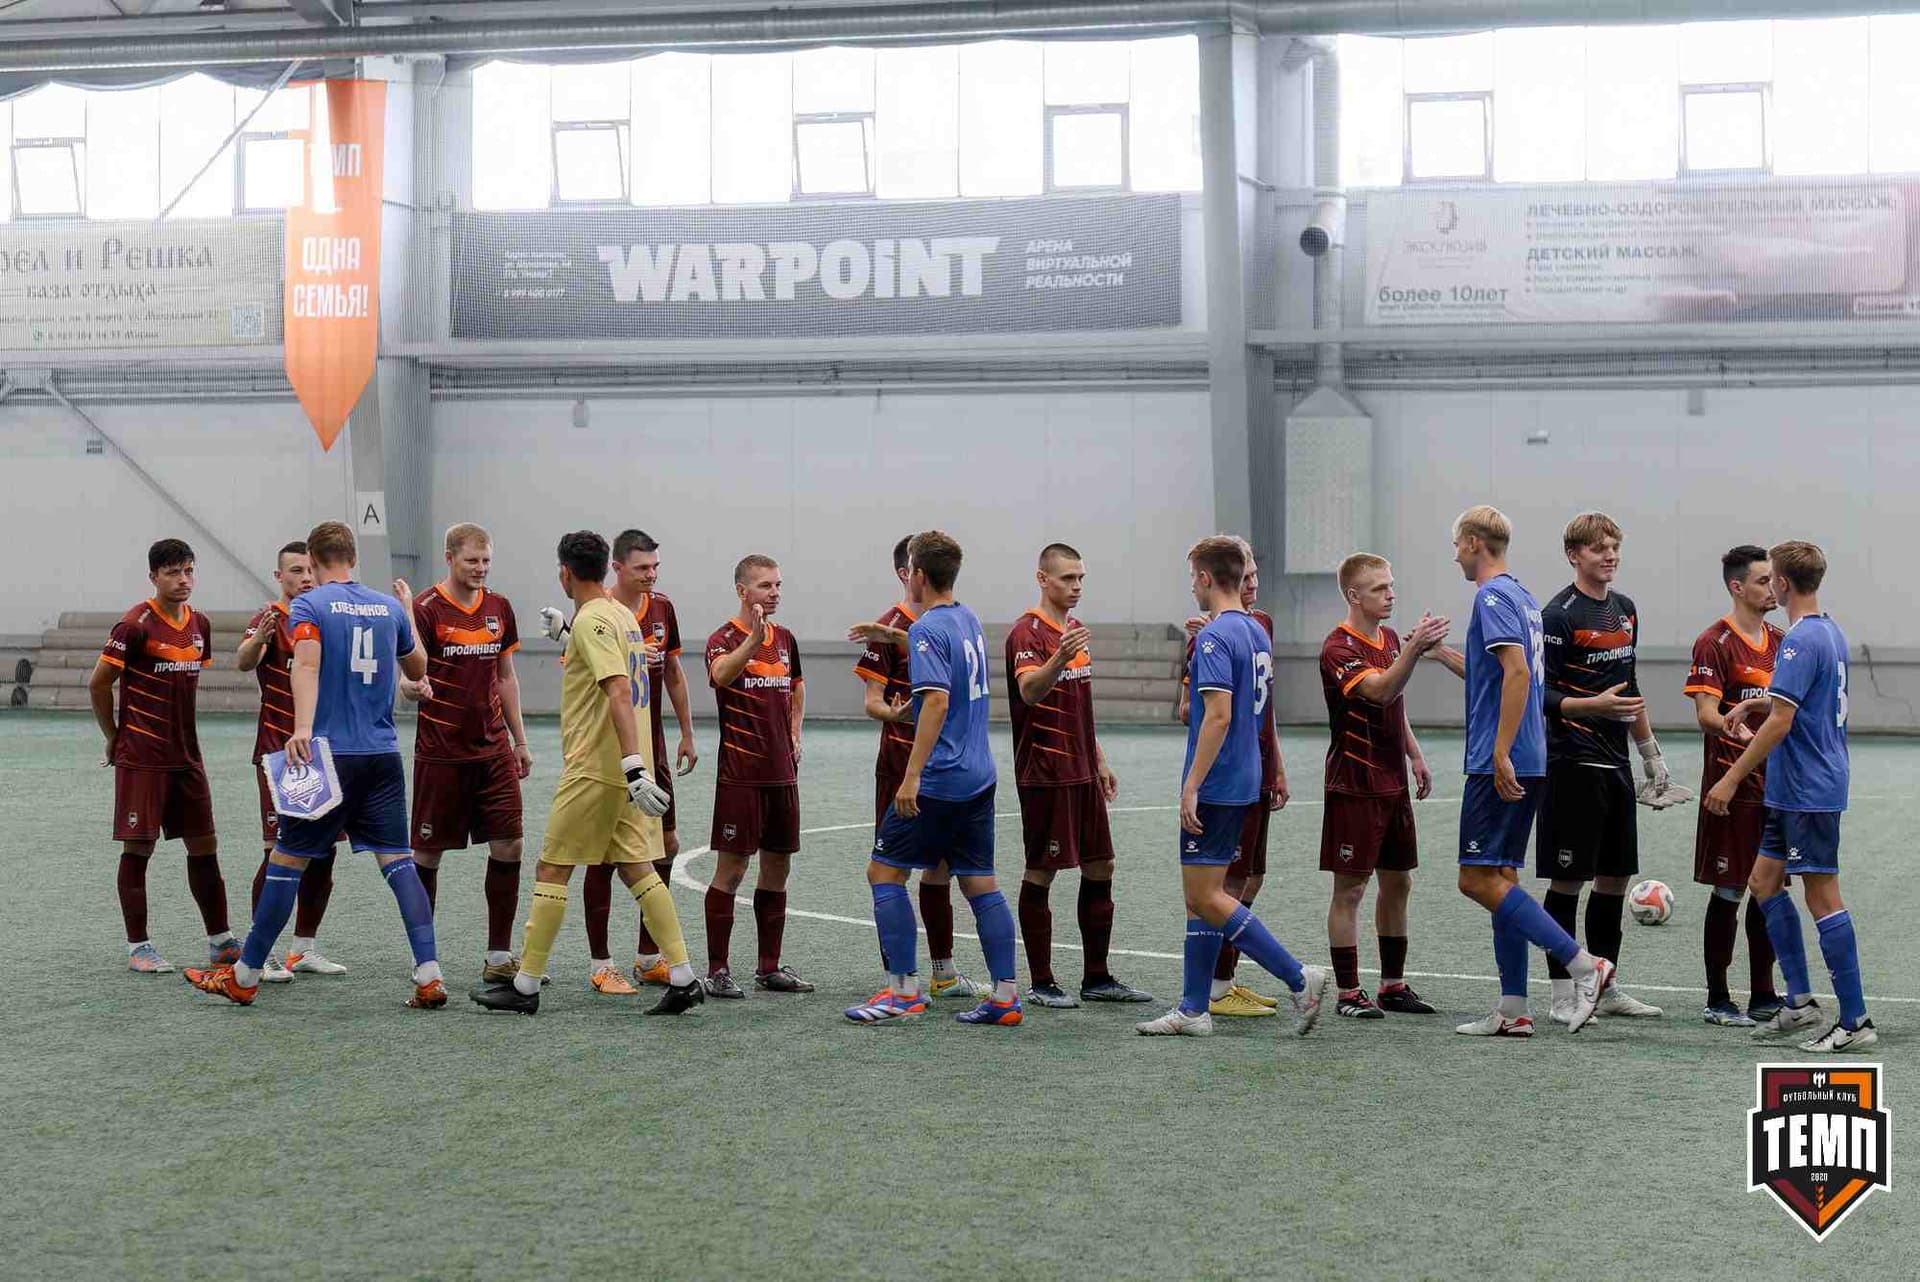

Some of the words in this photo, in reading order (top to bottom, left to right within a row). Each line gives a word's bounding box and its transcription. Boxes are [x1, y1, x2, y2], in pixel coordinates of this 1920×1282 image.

[303, 236, 361, 275] ОДНА
[1025, 239, 1073, 254] АРЕНА
[1527, 243, 1609, 261] ДЕТСКИЙ
[1025, 252, 1132, 271] ВИРТУАЛЬНОЙ
[1025, 272, 1123, 289] РЕАЛЬНОСТИ
[293, 284, 369, 317] СЕМЬЯ!
[1379, 286, 1441, 302] более
[351, 627, 378, 685] 4
[963, 635, 989, 700] 21
